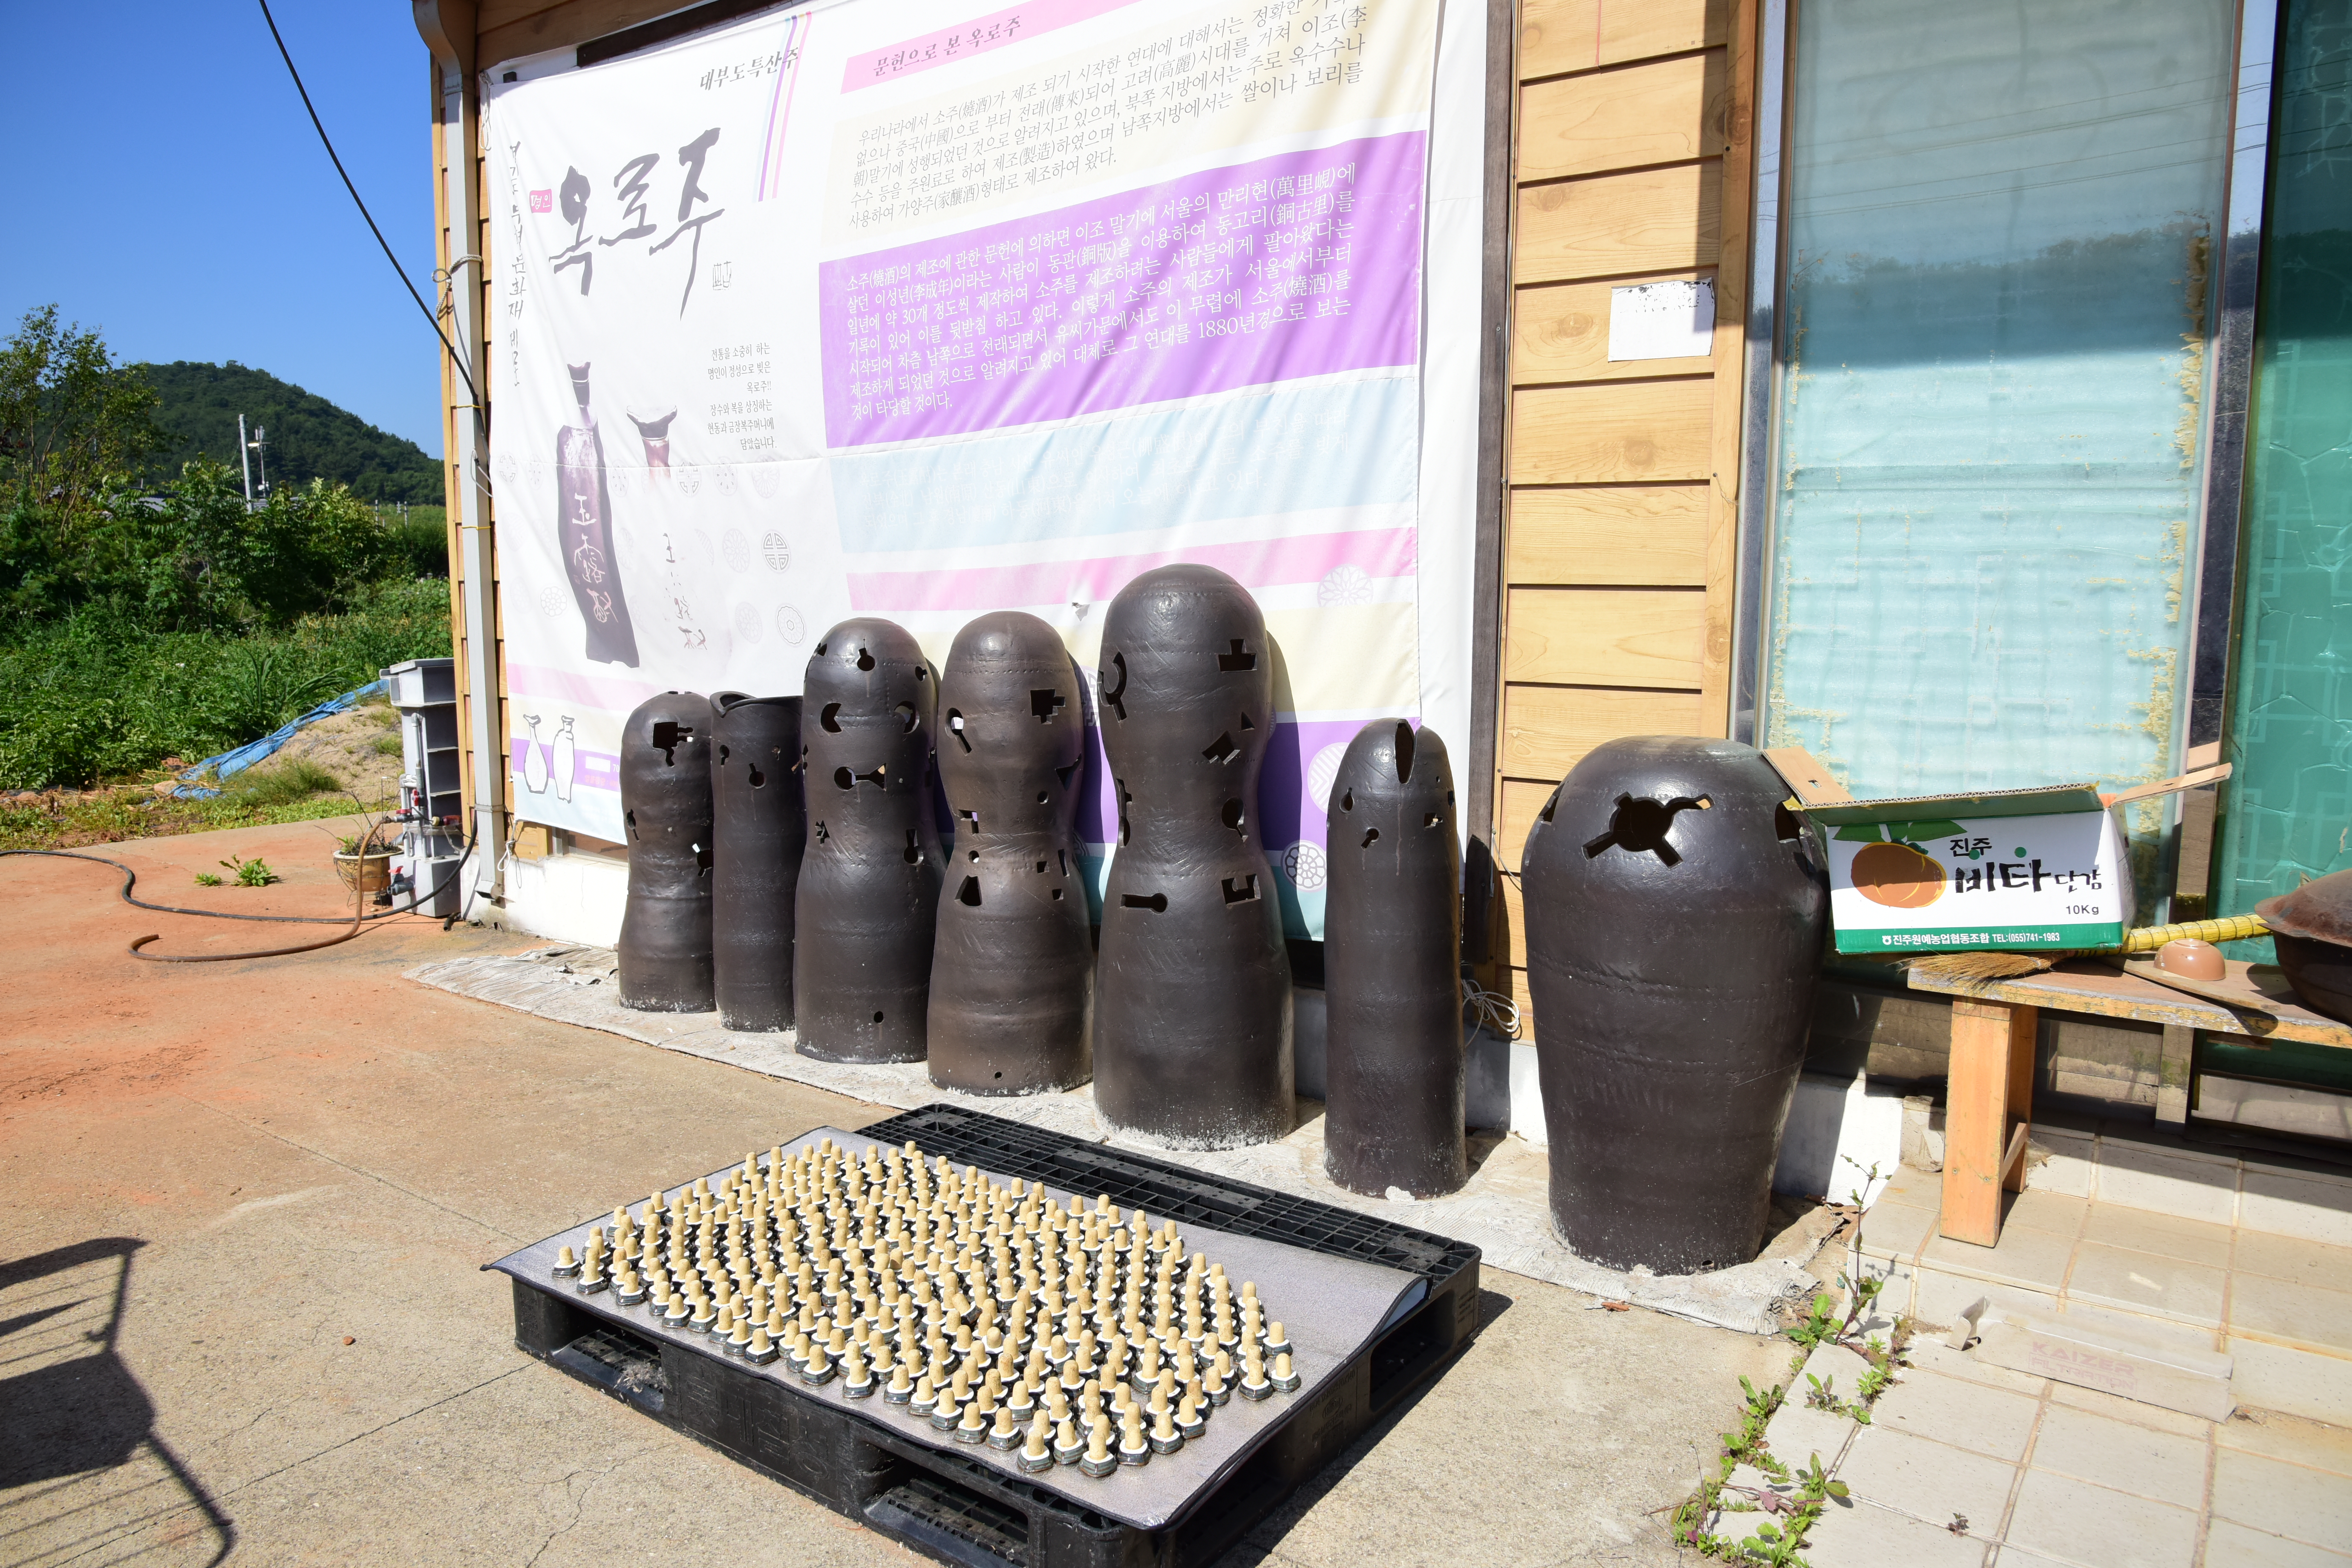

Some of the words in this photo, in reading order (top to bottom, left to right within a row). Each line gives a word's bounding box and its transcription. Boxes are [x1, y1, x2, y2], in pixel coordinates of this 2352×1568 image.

[873, 43, 937, 77] 문헌으로
[943, 35, 960, 56] 본
[966, 15, 1020, 48] 옥로주
[700, 47, 798, 91] 대부도특산주
[859, 112, 928, 147] 우리나라에서
[1011, 83, 1037, 103] 제조
[1043, 70, 1070, 93] 되기
[1077, 55, 1121, 83] 시작한
[1127, 37, 1172, 67] 연대에
[1180, 17, 1244, 49] 대해서는
[1251, 0, 1300, 28] 정확한
[857, 143, 891, 167] 없으나
[985, 109, 1011, 133] 부터
[1257, 21, 1290, 47] 거쳐
[908, 143, 967, 174] 성행되었던
[972, 132, 1009, 158] 것으로
[1015, 115, 1069, 145] 알려지고
[1074, 99, 1120, 130] 있으며,
[1125, 88, 1156, 112] 북쪽
[1160, 66, 1242, 101] 지방에서는
[1246, 51, 1283, 76] 주로
[1288, 33, 1366, 67] 옥수수나
[850, 189, 873, 208] 수수
[879, 182, 902, 202] 등을
[907, 169, 955, 195] 주원료로
[962, 159, 986, 181] 하여
[1122, 92, 1233, 138] 남쪽지방에서는
[1241, 73, 1297, 103] 쌀이나
[1305, 62, 1363, 87] 보리를
[849, 204, 894, 229] 사용하여
[1023, 156, 1079, 186] 제조하여
[1085, 146, 1116, 173] 왔다.
[548, 127, 725, 321] 옥로주
[915, 254, 951, 278] 제조에
[955, 248, 981, 270] 관한
[984, 237, 1023, 264] 문헌에
[1028, 227, 1070, 253] 의하면
[1075, 220, 1105, 242] 이조
[1110, 205, 1155, 235] 말기에
[1161, 192, 1210, 221] 서울의
[847, 293, 869, 314] 살던
[999, 257, 1038, 283] 사람이
[1141, 219, 1205, 251] 이용하여
[848, 313, 879, 335] 일년에
[885, 310, 897, 329] 약
[902, 304, 927, 325] 30개
[933, 295, 969, 320] 정도씩
[976, 283, 1027, 311] 제작하여
[1035, 274, 1078, 298] 소주를
[1085, 257, 1162, 288] 제조하려는
[1169, 234, 1253, 270] 사람들에게
[1263, 218, 1355, 253] 팔아왔다는
[849, 334, 880, 357] 기록이
[888, 329, 910, 351] 있어
[918, 325, 942, 345] 이를
[950, 315, 986, 340] 뒷받침
[995, 310, 1023, 331] 하고
[1029, 301, 1062, 325] 있다.
[1072, 289, 1114, 316] 이렇게
[1123, 277, 1172, 303] 소주의
[1182, 264, 1233, 292] 제조가
[1245, 242, 1351, 281] 서울에서부터
[712, 347, 730, 361] 전통을
[732, 344, 752, 357] 소중히
[756, 343, 770, 355] 하는
[849, 355, 892, 378] 시작되어
[898, 351, 922, 371] 차츰
[926, 342, 976, 367] 남쪽으로
[981, 327, 1047, 357] 전래되면서
[1055, 306, 1159, 344] 유씨가문에서도
[1167, 299, 1180, 320] 이
[1189, 288, 1241, 317] 무렵에
[850, 376, 894, 400] 제조하게
[898, 371, 933, 393] 되었던
[938, 365, 976, 387] 것으로
[981, 355, 1035, 380] 알려지고
[1040, 348, 1066, 371] 있어
[1073, 339, 1119, 364] 대체로
[1123, 335, 1138, 352] 그
[1145, 323, 1191, 349] 연대를
[1198, 303, 1307, 338] 1880년경으로
[1314, 297, 1351, 318] 보는
[708, 366, 727, 380] 명인이
[729, 364, 755, 378] 정성으로
[757, 361, 771, 375] 빚은
[747, 380, 772, 394] 옥로주!!
[708, 421, 727, 435] 현동과
[729, 417, 775, 433] 금장복주머니에
[710, 402, 729, 417] 장수와
[731, 402, 743, 414] 복을
[746, 399, 772, 413] 상징하는
[852, 401, 872, 421] 것이
[876, 396, 911, 418] 타당할
[914, 391, 953, 413] 것이다.
[740, 436, 777, 450] 담았습니다.
[1949, 838, 1992, 857] 진주
[1955, 859, 2052, 894] 비타
[2054, 869, 2102, 894] 단감
[2065, 904, 2099, 915] 10Kg
[1893, 933, 1989, 945] 진주원예농업협동조합
[1993, 932, 2060, 944] TEL:(055)741-1983
[2031, 1357, 2135, 1390] FILTRATION
[2032, 1341, 2135, 1377] KAIZER
